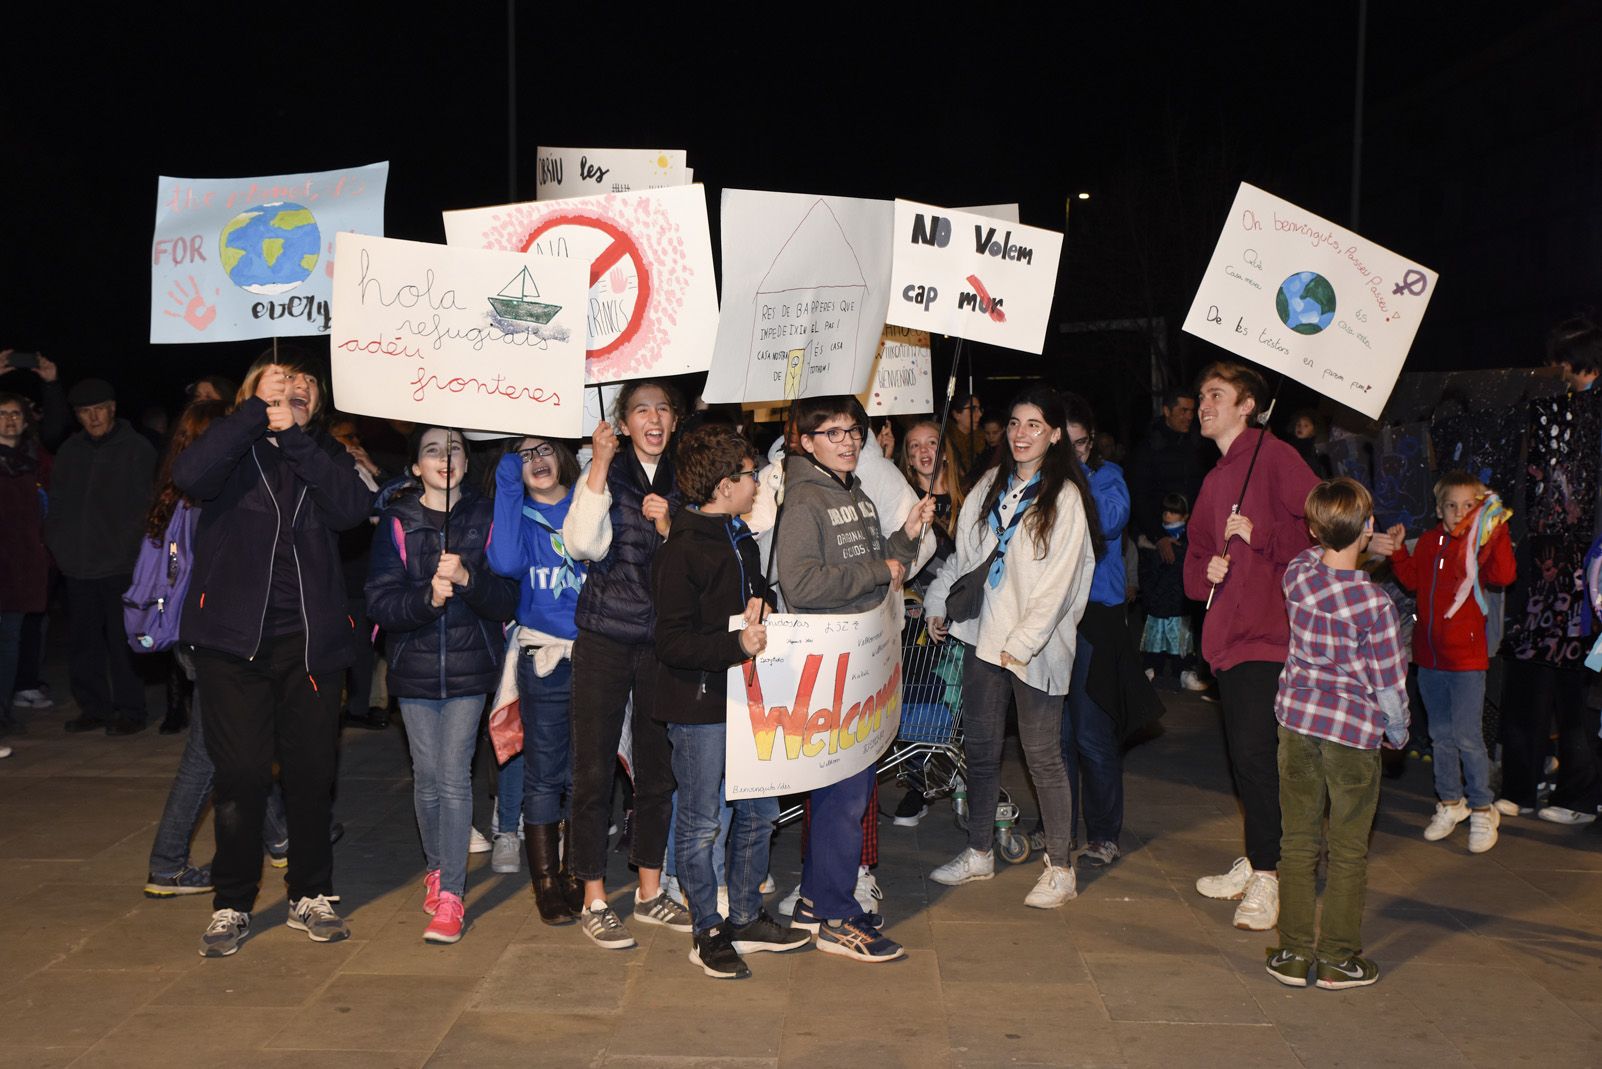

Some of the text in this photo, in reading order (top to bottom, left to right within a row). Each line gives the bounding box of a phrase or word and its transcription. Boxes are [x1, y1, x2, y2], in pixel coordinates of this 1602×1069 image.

[1242, 209, 1262, 231] Oh
[154, 235, 207, 267] FOR
[911, 213, 1034, 265] NO Volem
[359, 248, 467, 310] hola
[782, 304, 791, 318] DE
[840, 300, 855, 313] QUE
[902, 284, 938, 312] cap
[1206, 305, 1222, 325] De
[338, 333, 425, 359] adéu
[396, 314, 549, 350] refugiats
[410, 367, 561, 406] fronteres
[773, 371, 782, 381] DE
